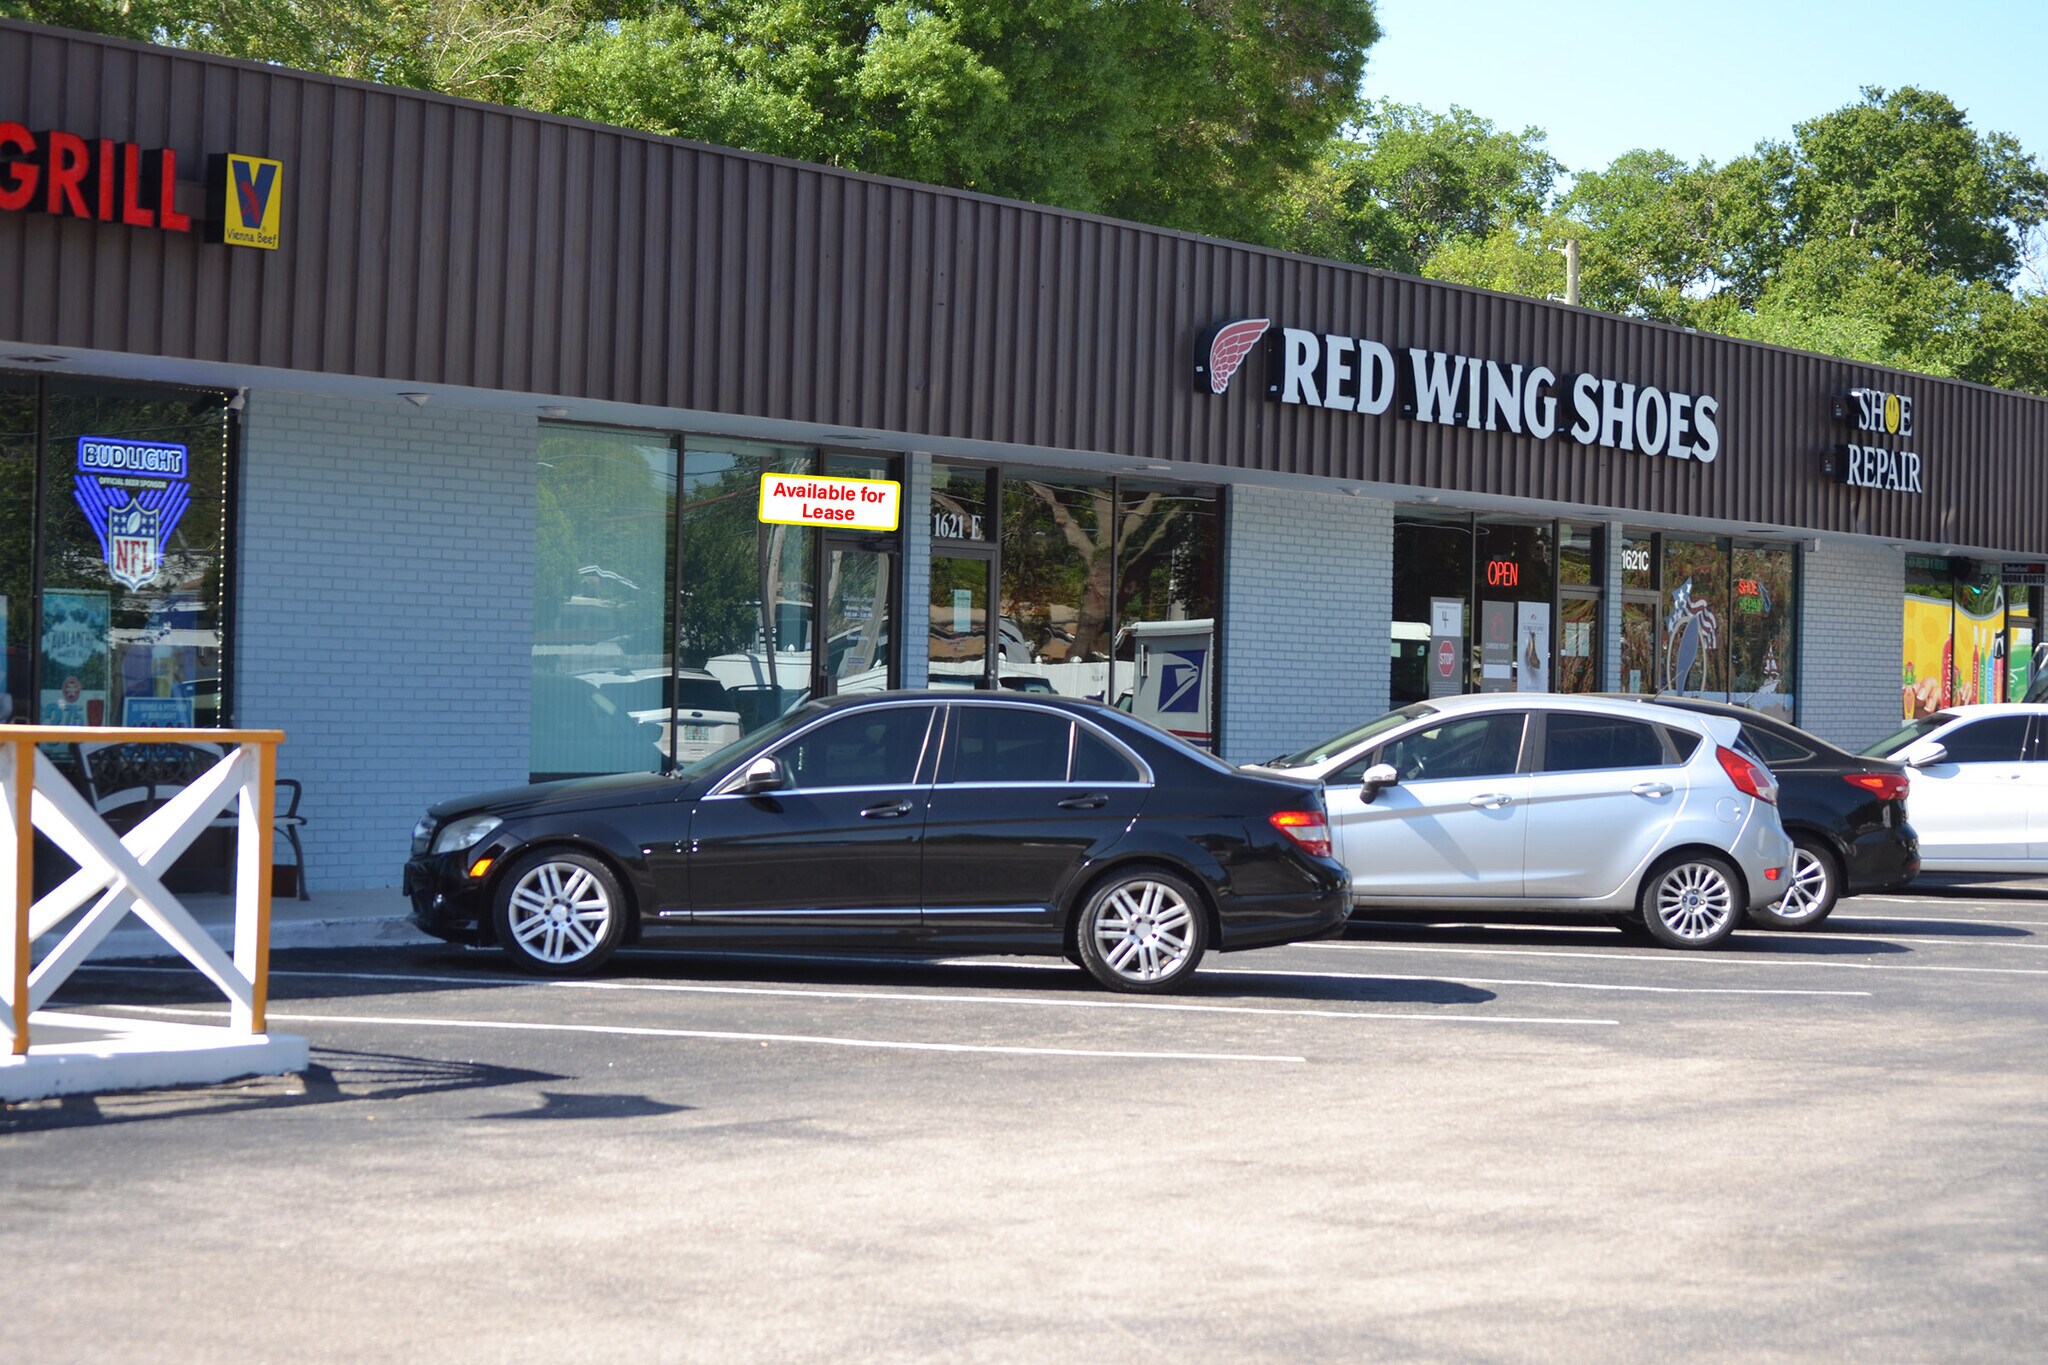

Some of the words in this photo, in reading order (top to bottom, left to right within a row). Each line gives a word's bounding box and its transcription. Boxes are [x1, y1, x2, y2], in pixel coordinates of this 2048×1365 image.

[0, 121, 191, 232] GRILL
[226, 228, 255, 242] Vienna
[257, 233, 277, 247] Beef
[1281, 327, 1396, 416] RED
[1409, 347, 1557, 440] WING
[1570, 372, 1719, 463] SHOES
[83, 443, 126, 468] BUD
[126, 446, 182, 473] LIGHT
[1846, 443, 1922, 494] REPAIR
[98, 476, 124, 486] OFFICIAL
[124, 478, 139, 487] BEER
[139, 479, 167, 488] SPONSOR
[933, 512, 965, 540] 1621
[970, 514, 982, 540] E
[115, 539, 152, 578] NFL
[1621, 549, 1649, 571] 1621C
[1487, 560, 1519, 587] OPEN
[2001, 574, 2021, 583] WORK
[2023, 574, 2046, 584] BOOTS
[1439, 652, 1454, 665] STOP
